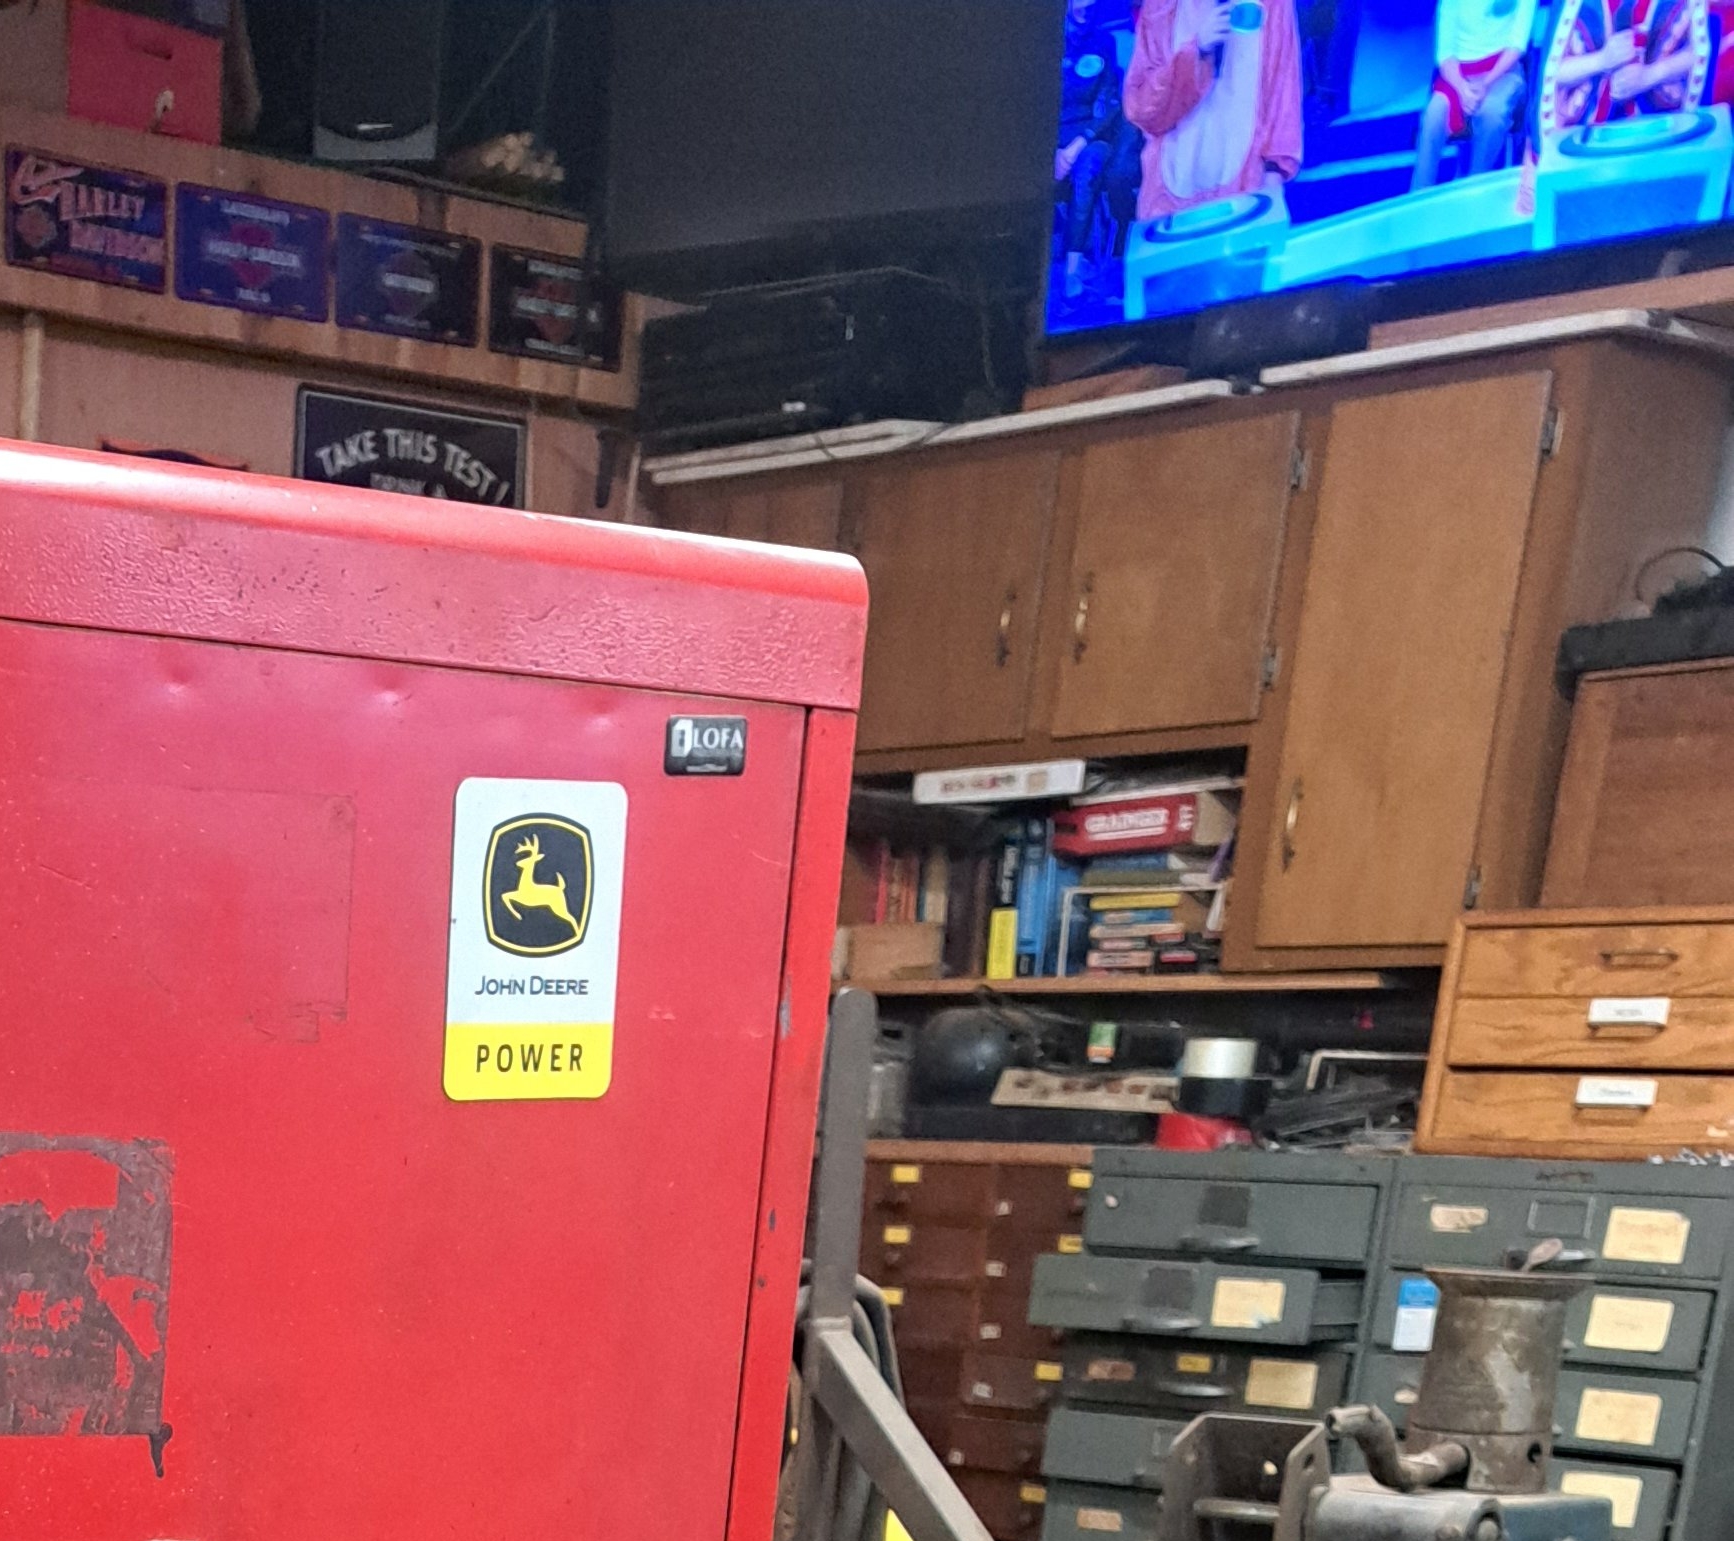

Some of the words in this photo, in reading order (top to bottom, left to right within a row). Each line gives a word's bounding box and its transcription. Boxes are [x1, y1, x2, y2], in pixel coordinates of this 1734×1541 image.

[316, 429, 380, 477] TAKE
[383, 427, 438, 464] THIS
[444, 441, 497, 497] TEST
[692, 726, 745, 750] LOFA
[474, 975, 526, 996] JOHN
[529, 975, 590, 996] DEERE
[476, 1043, 584, 1073] POWER
